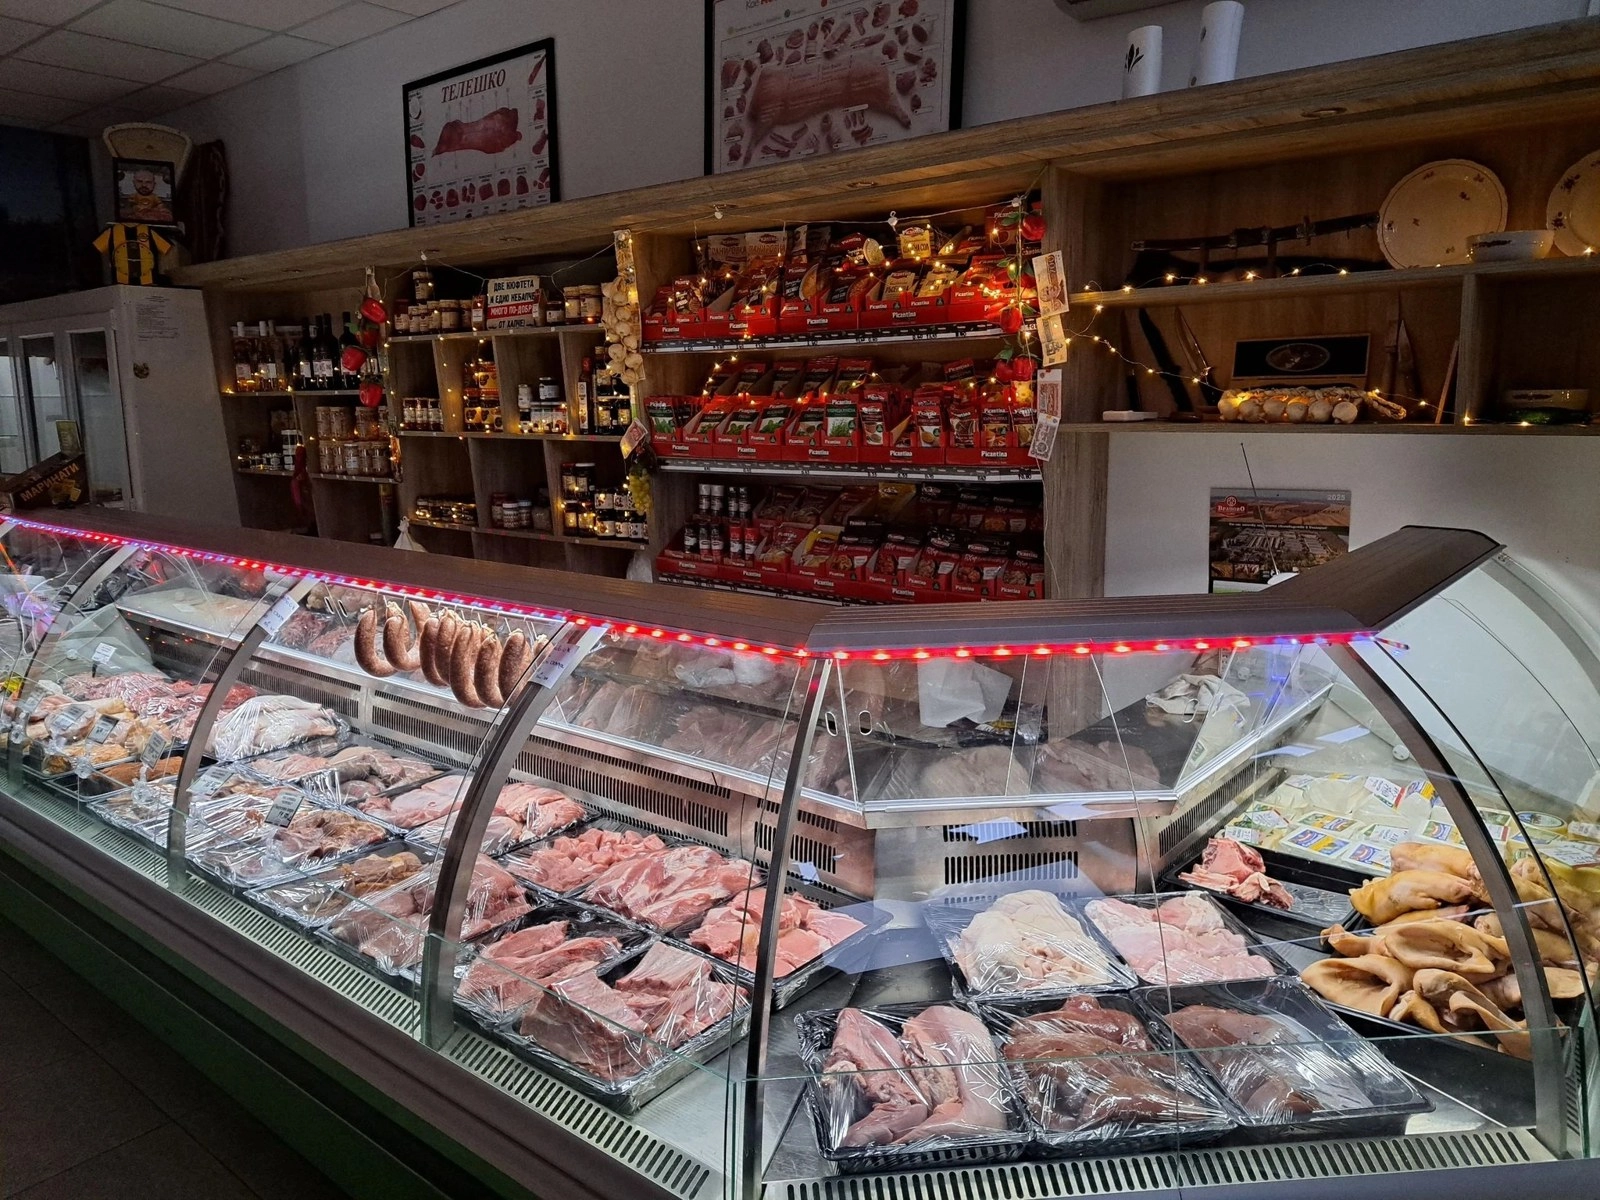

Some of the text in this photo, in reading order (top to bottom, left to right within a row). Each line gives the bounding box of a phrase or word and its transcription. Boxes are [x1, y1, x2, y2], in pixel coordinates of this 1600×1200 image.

[441, 69, 506, 104] ТЕЛЕШКО
[494, 281, 505, 292] ДВЕ
[495, 294, 510, 304] ЕДНО
[490, 303, 533, 316] МНОГО ПО-ДОБР
[892, 309, 917, 319] Picantina
[498, 320, 506, 329] ОТ
[729, 321, 749, 330] Picantina
[806, 317, 829, 326] Picantina
[672, 443, 689, 451] Picantina
[737, 446, 757, 454] Picantina
[808, 448, 830, 457] Picantina
[889, 449, 913, 457] Picantina
[980, 449, 1008, 458] Picantina
[20, 461, 80, 503] МАРИНАТИ
[967, 544, 990, 553] Picantina
[1016, 549, 1039, 559] Picantina
[678, 561, 697, 570] Picantina
[742, 570, 762, 578] Picantina
[813, 578, 835, 588] Picantina
[891, 588, 915, 598] Picantina
[1000, 587, 1022, 595] Picantina
